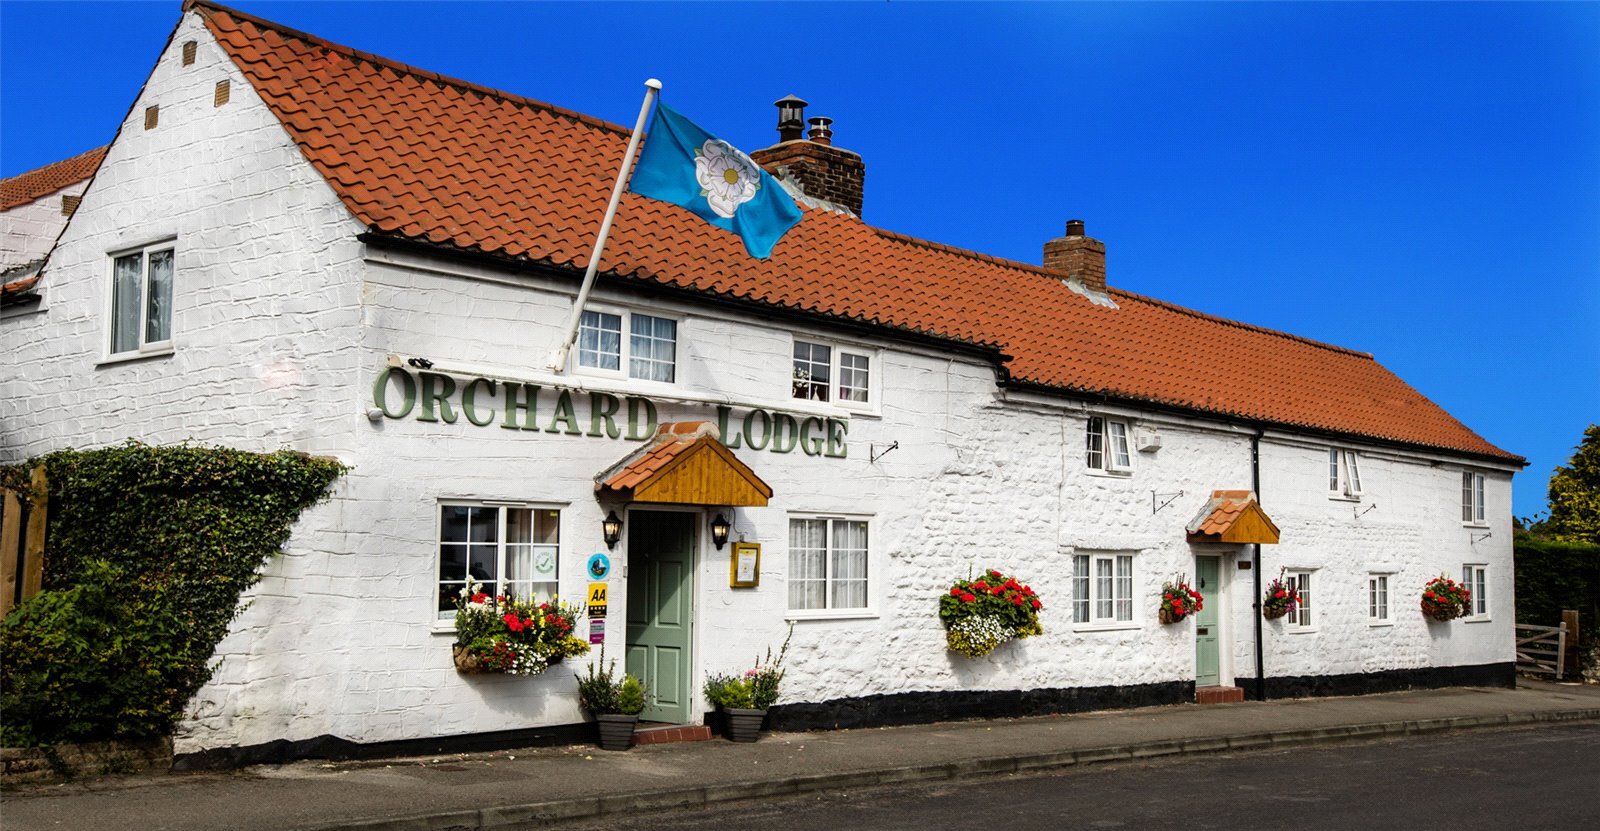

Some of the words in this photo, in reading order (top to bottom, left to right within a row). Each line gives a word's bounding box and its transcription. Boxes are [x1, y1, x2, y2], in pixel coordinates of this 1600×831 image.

[374, 367, 657, 441] ORCHARD
[717, 405, 848, 458] LODGE
[591, 589, 606, 602] AA
